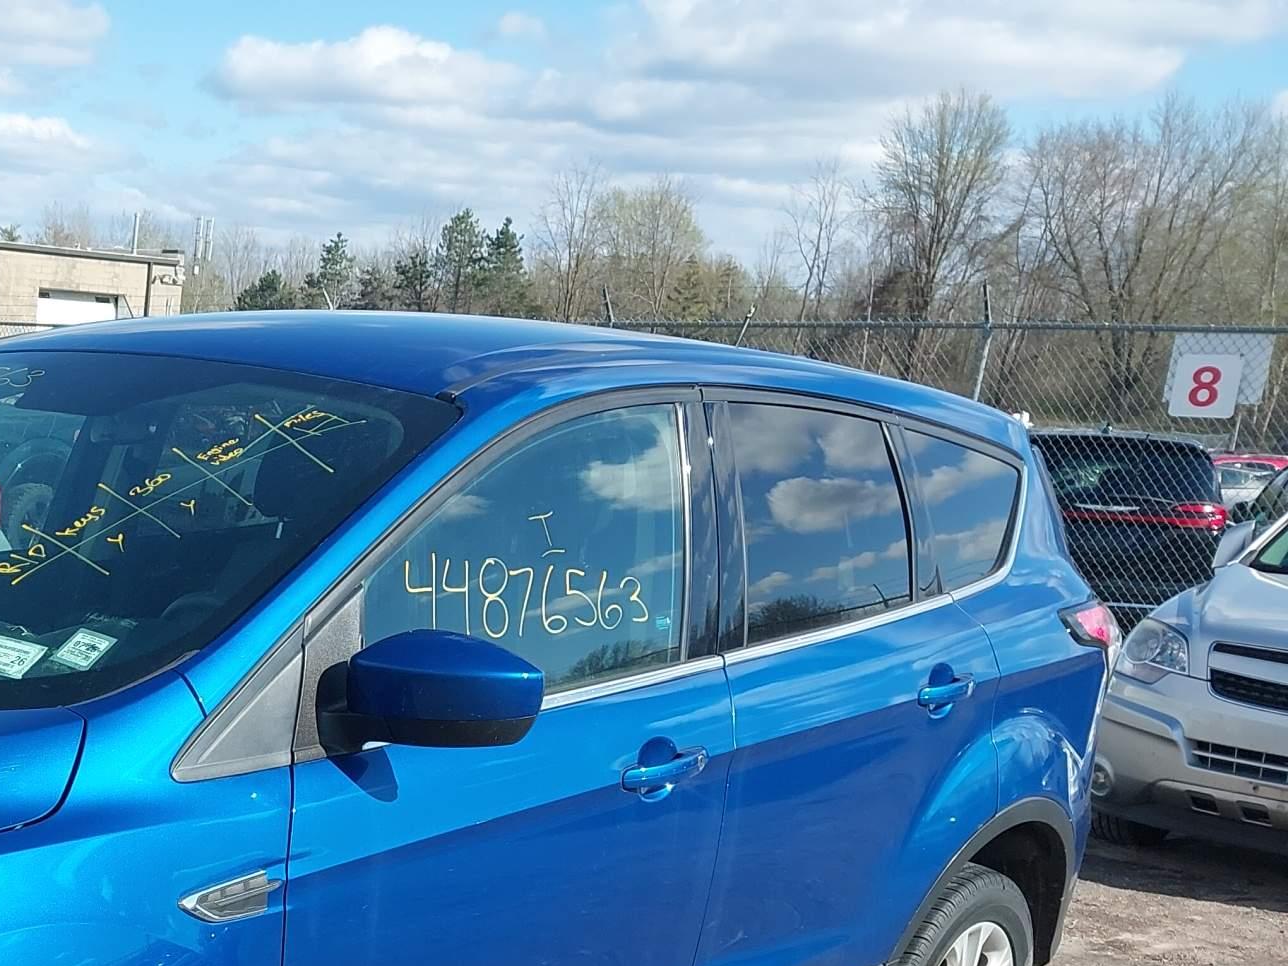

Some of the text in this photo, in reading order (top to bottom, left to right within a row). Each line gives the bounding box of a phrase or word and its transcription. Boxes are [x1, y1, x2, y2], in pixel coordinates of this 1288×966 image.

[1188, 365, 1222, 408] 8
[128, 472, 172, 497] 360
[179, 499, 197, 517] Y
[106, 532, 126, 553] Y
[404, 552, 649, 639] 44876563
[10, 655, 26, 667] 26
